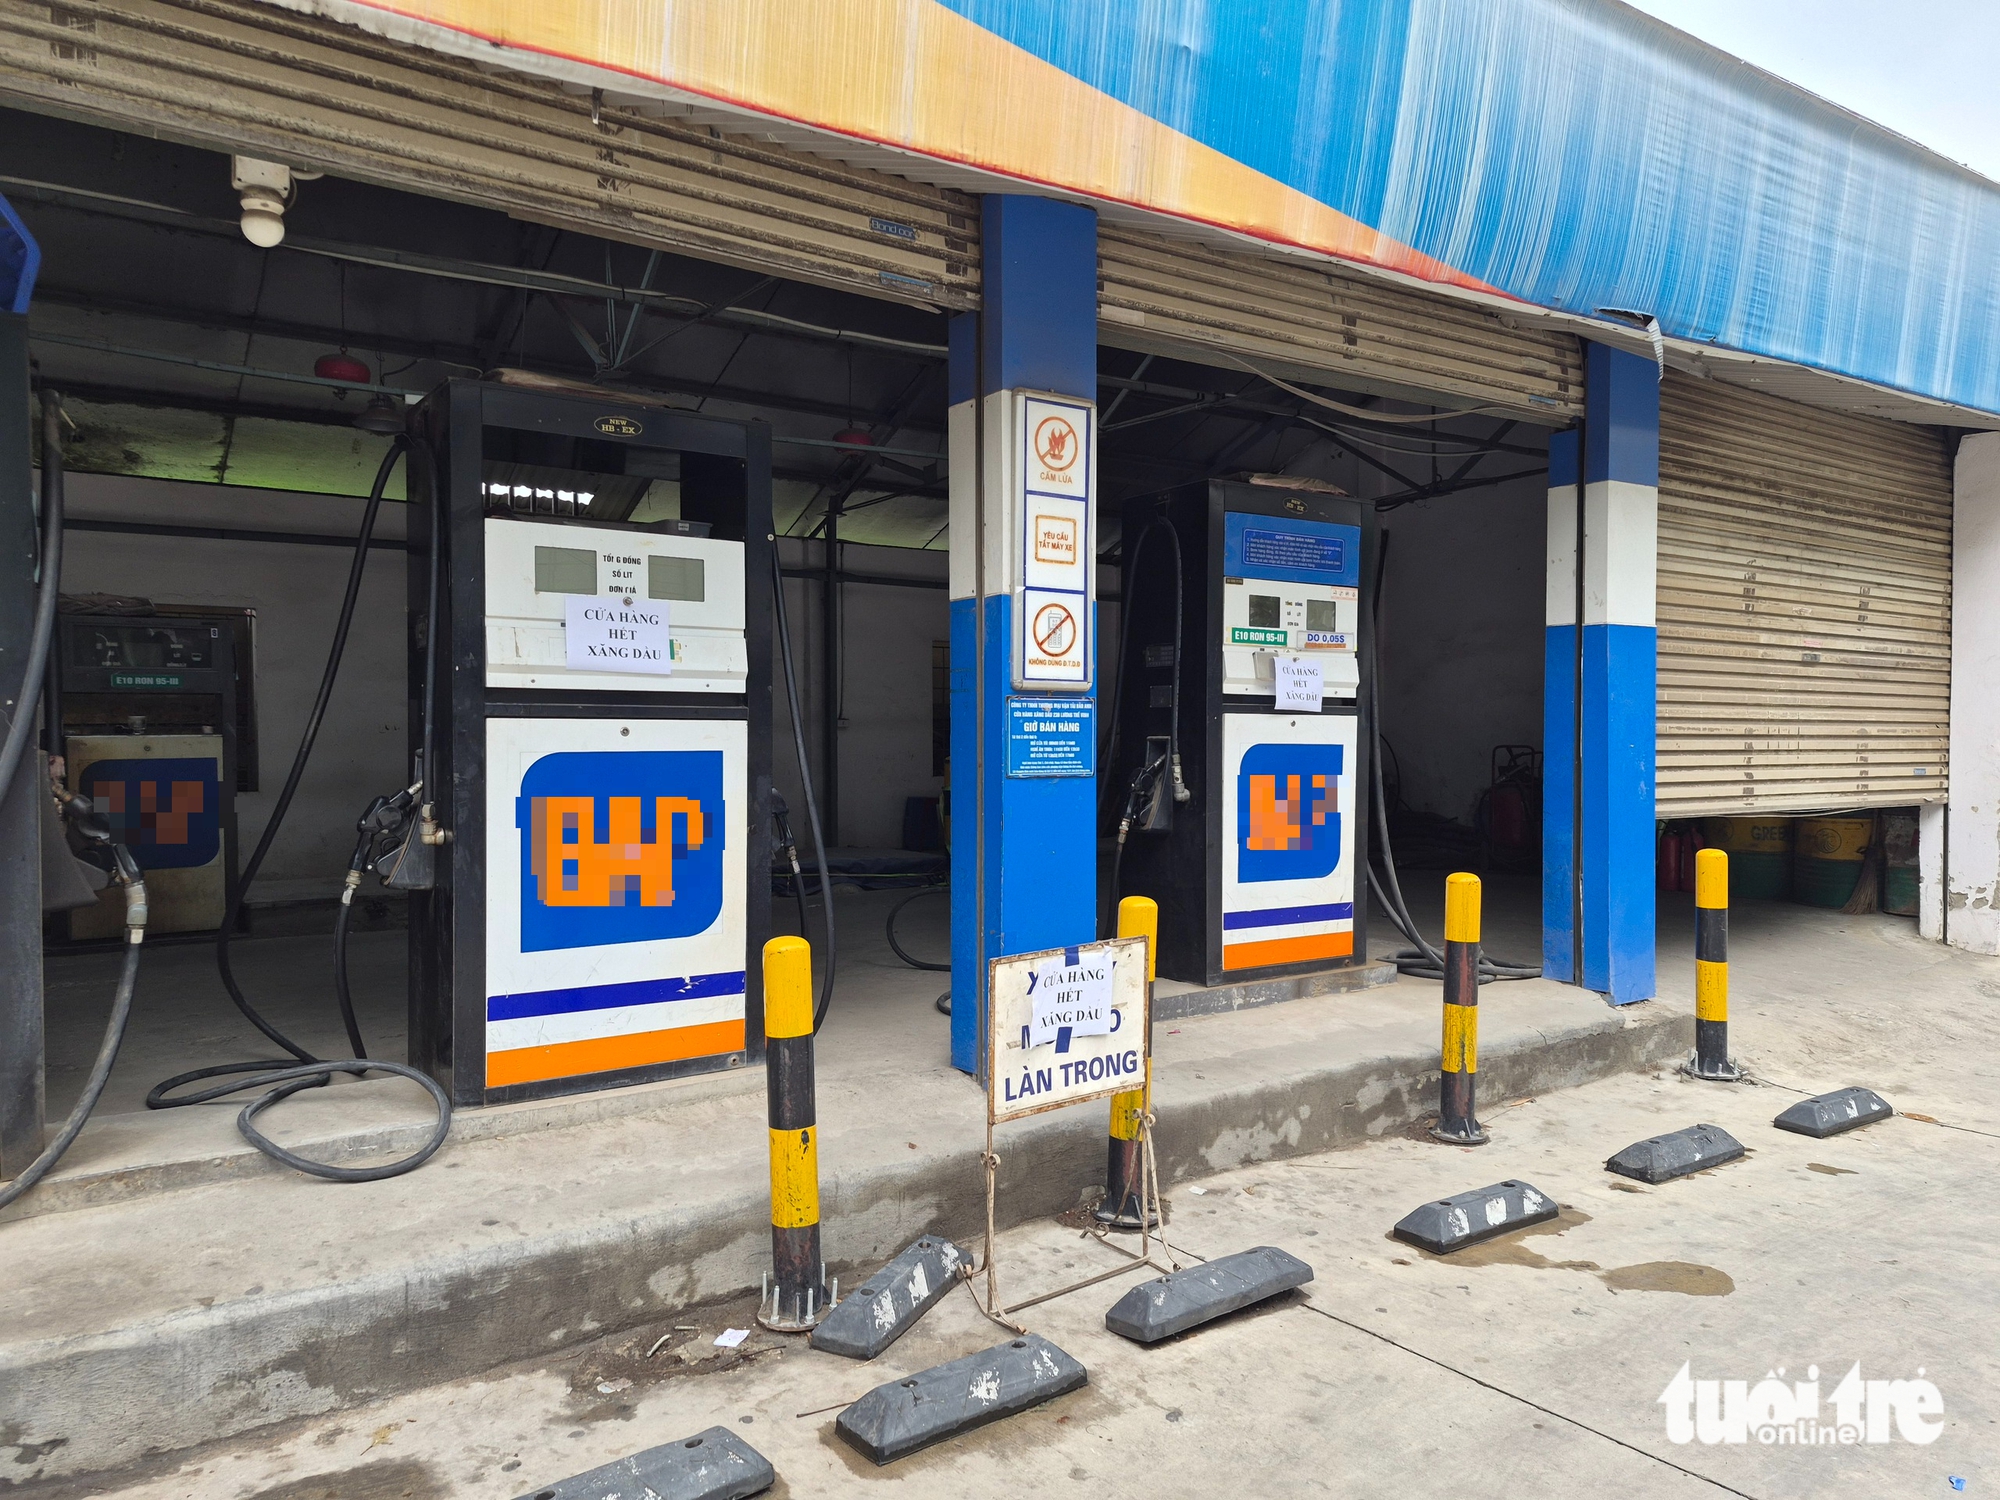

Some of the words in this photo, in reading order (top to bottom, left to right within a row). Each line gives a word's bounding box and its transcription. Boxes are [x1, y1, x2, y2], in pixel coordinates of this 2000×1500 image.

[609, 418, 628, 426] NEW
[601, 424, 615, 432] HB
[621, 426, 636, 434] EX
[1040, 470, 1056, 482] CẤM
[1058, 472, 1072, 484] LỬA
[1043, 531, 1055, 540] YÊU
[1051, 542, 1064, 550] MÁY
[612, 568, 622, 578] SỐ
[609, 585, 624, 593] ĐƠN
[584, 607, 615, 622] CỬA
[619, 609, 659, 625] HÀNG
[609, 627, 638, 640] HẾT
[1235, 630, 1248, 641] E10
[1249, 631, 1265, 642] RON
[1265, 632, 1284, 643] 95-III
[1307, 633, 1320, 642] DO
[1322, 633, 1345, 644] 0,05S
[588, 643, 628, 658] XĂNG
[633, 646, 661, 660] DẦU
[1028, 657, 1047, 665] KHÔNG
[1048, 658, 1063, 666] DÙNG
[1282, 665, 1296, 675] CỬA
[1296, 666, 1318, 677] HÀNG
[116, 676, 133, 685] E10
[135, 676, 154, 685] RON
[155, 677, 179, 685] 95-III
[1293, 678, 1308, 688] HẾT
[1286, 690, 1305, 701] XĂNG
[1023, 719, 1038, 732] GIỜ
[1040, 720, 1057, 732] BÁN
[1058, 720, 1080, 732] HÀNG
[1043, 969, 1064, 989] CỬA
[1067, 967, 1104, 984] HÀNG
[1056, 987, 1083, 1004] HẾT
[1040, 1011, 1073, 1029] XĂNG
[1005, 1065, 1053, 1102] LÀN
[1059, 1049, 1138, 1087] TRONG
